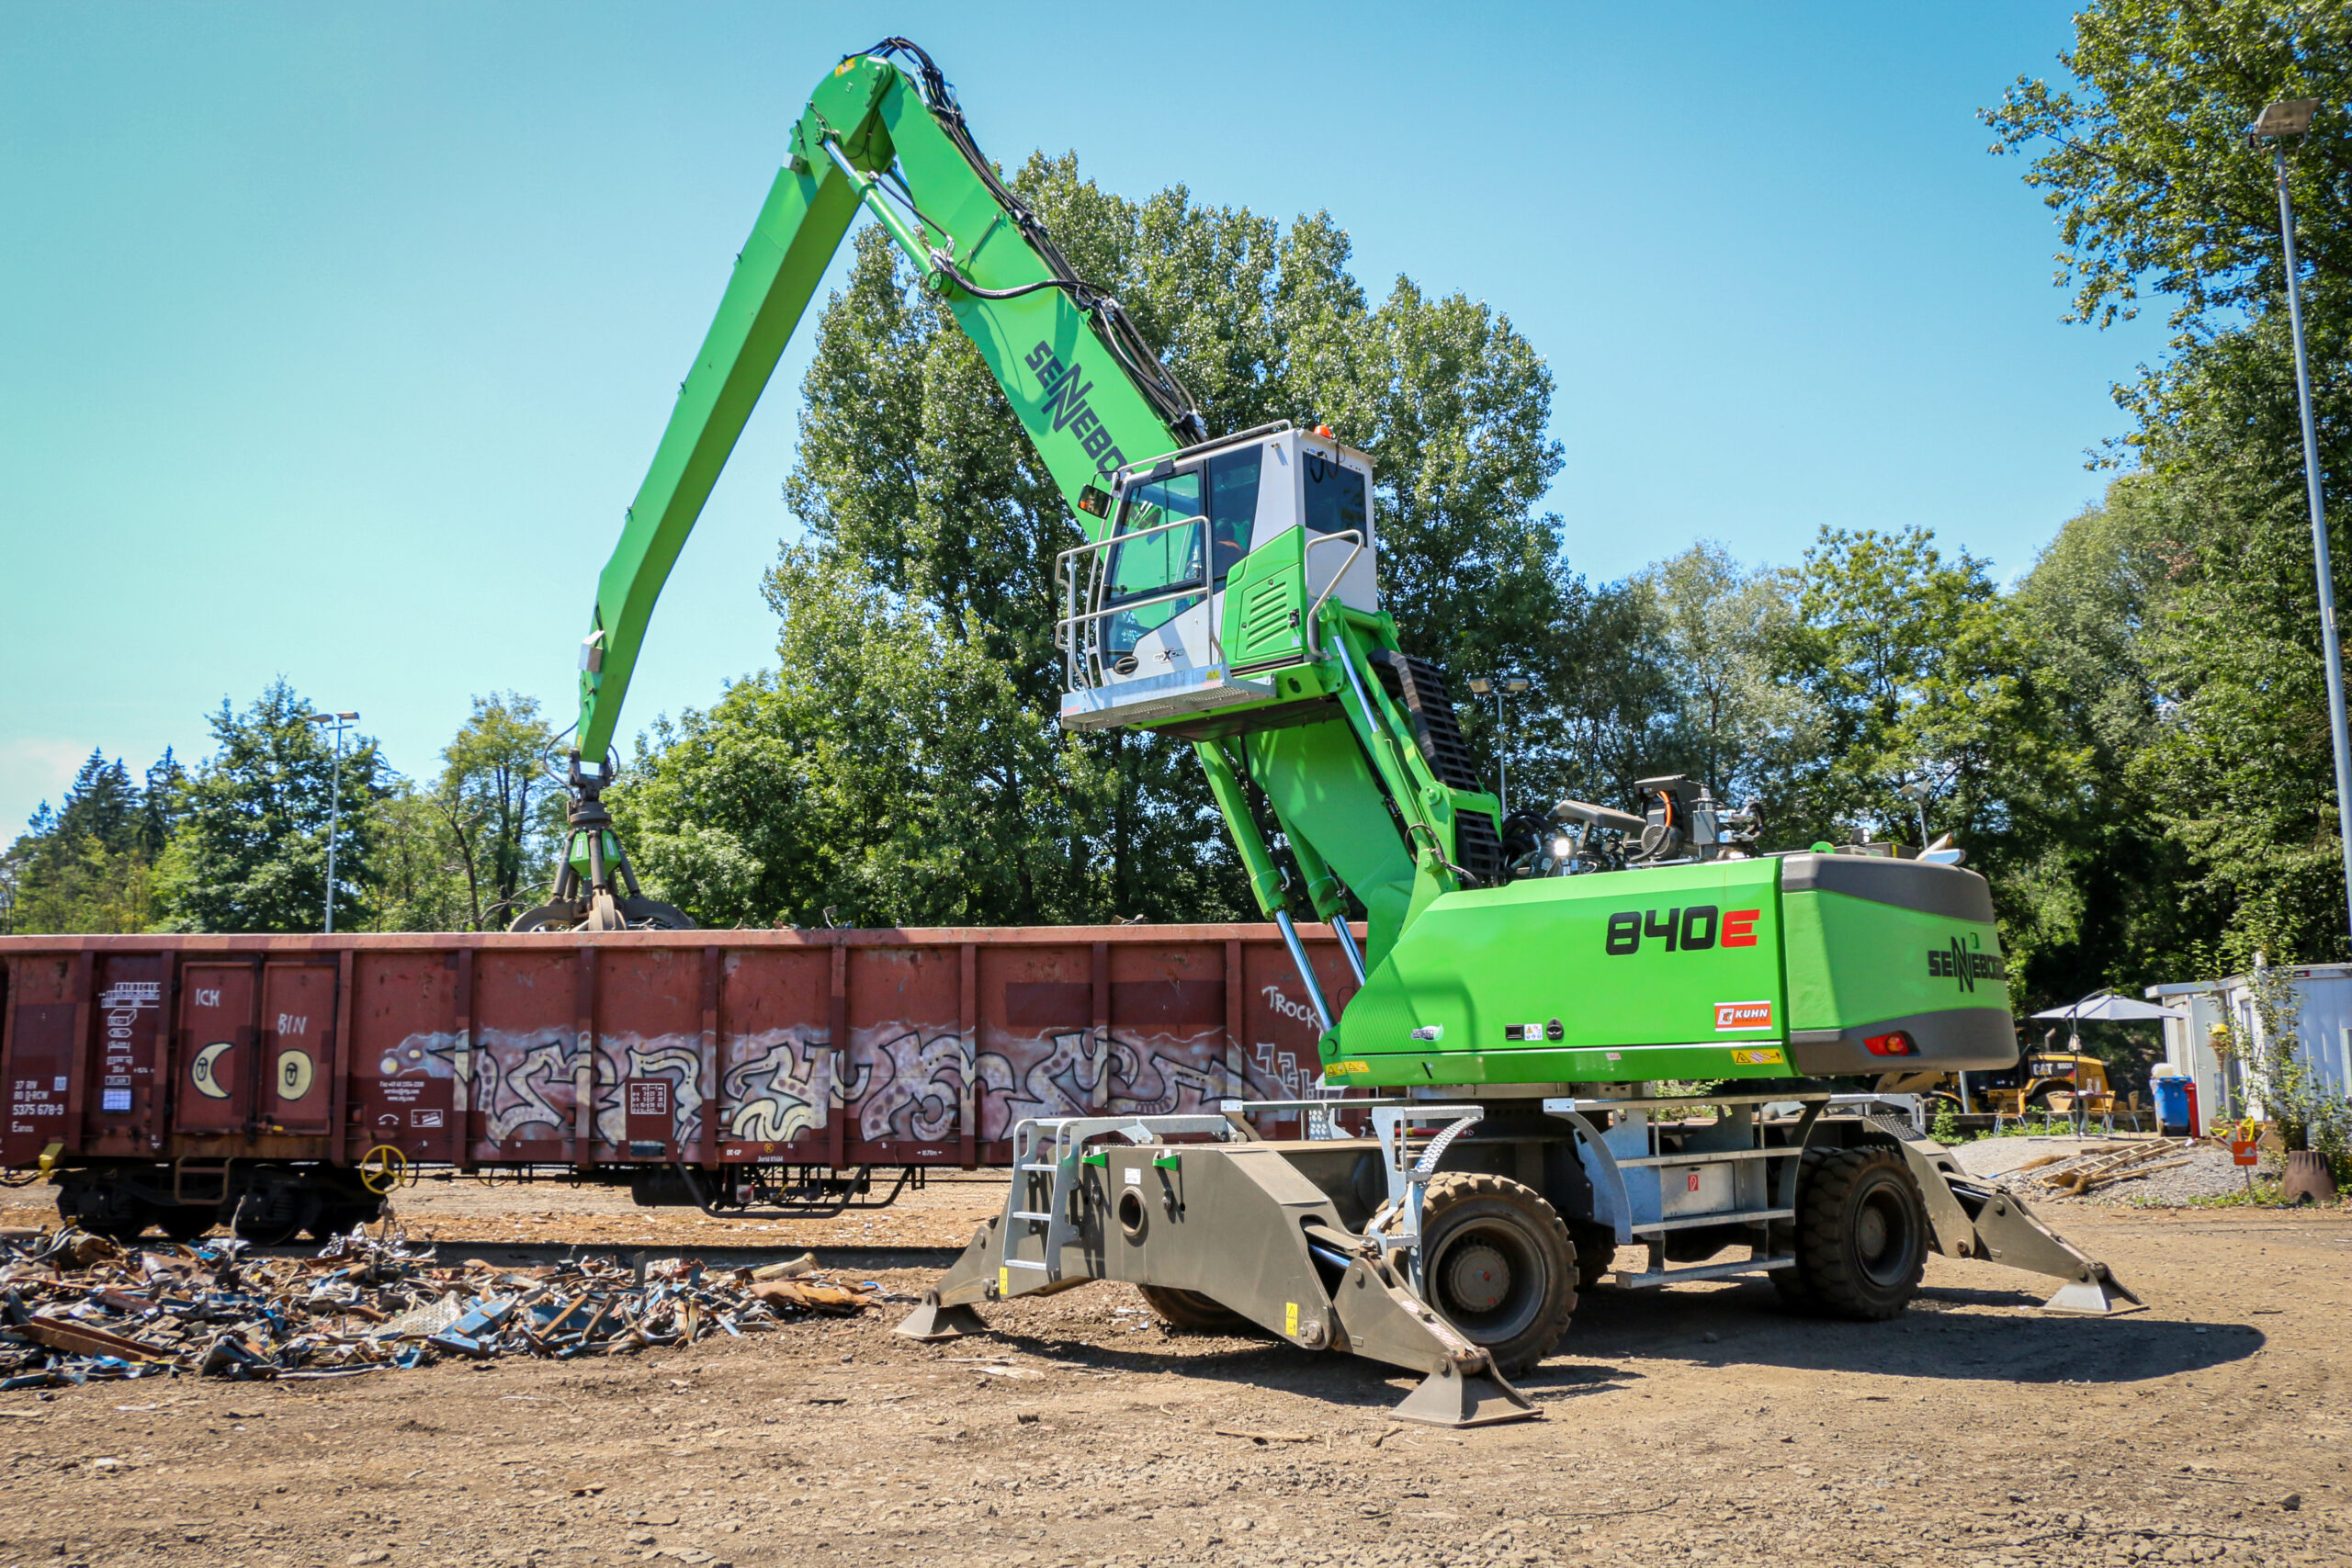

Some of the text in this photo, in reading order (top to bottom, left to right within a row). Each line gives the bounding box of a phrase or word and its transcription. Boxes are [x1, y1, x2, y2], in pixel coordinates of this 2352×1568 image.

[1024, 340, 1134, 482] SENNEBO
[1605, 905, 1761, 956] 840E
[196, 988, 220, 1007] ICH
[1261, 986, 1321, 1031] TROCK
[1735, 1009, 1769, 1018] KUHN
[277, 1013, 307, 1035] BIN
[2033, 1063, 2053, 1076] CAT
[15, 1080, 25, 1089] 37
[13, 1104, 64, 1115] 5375 678-9
